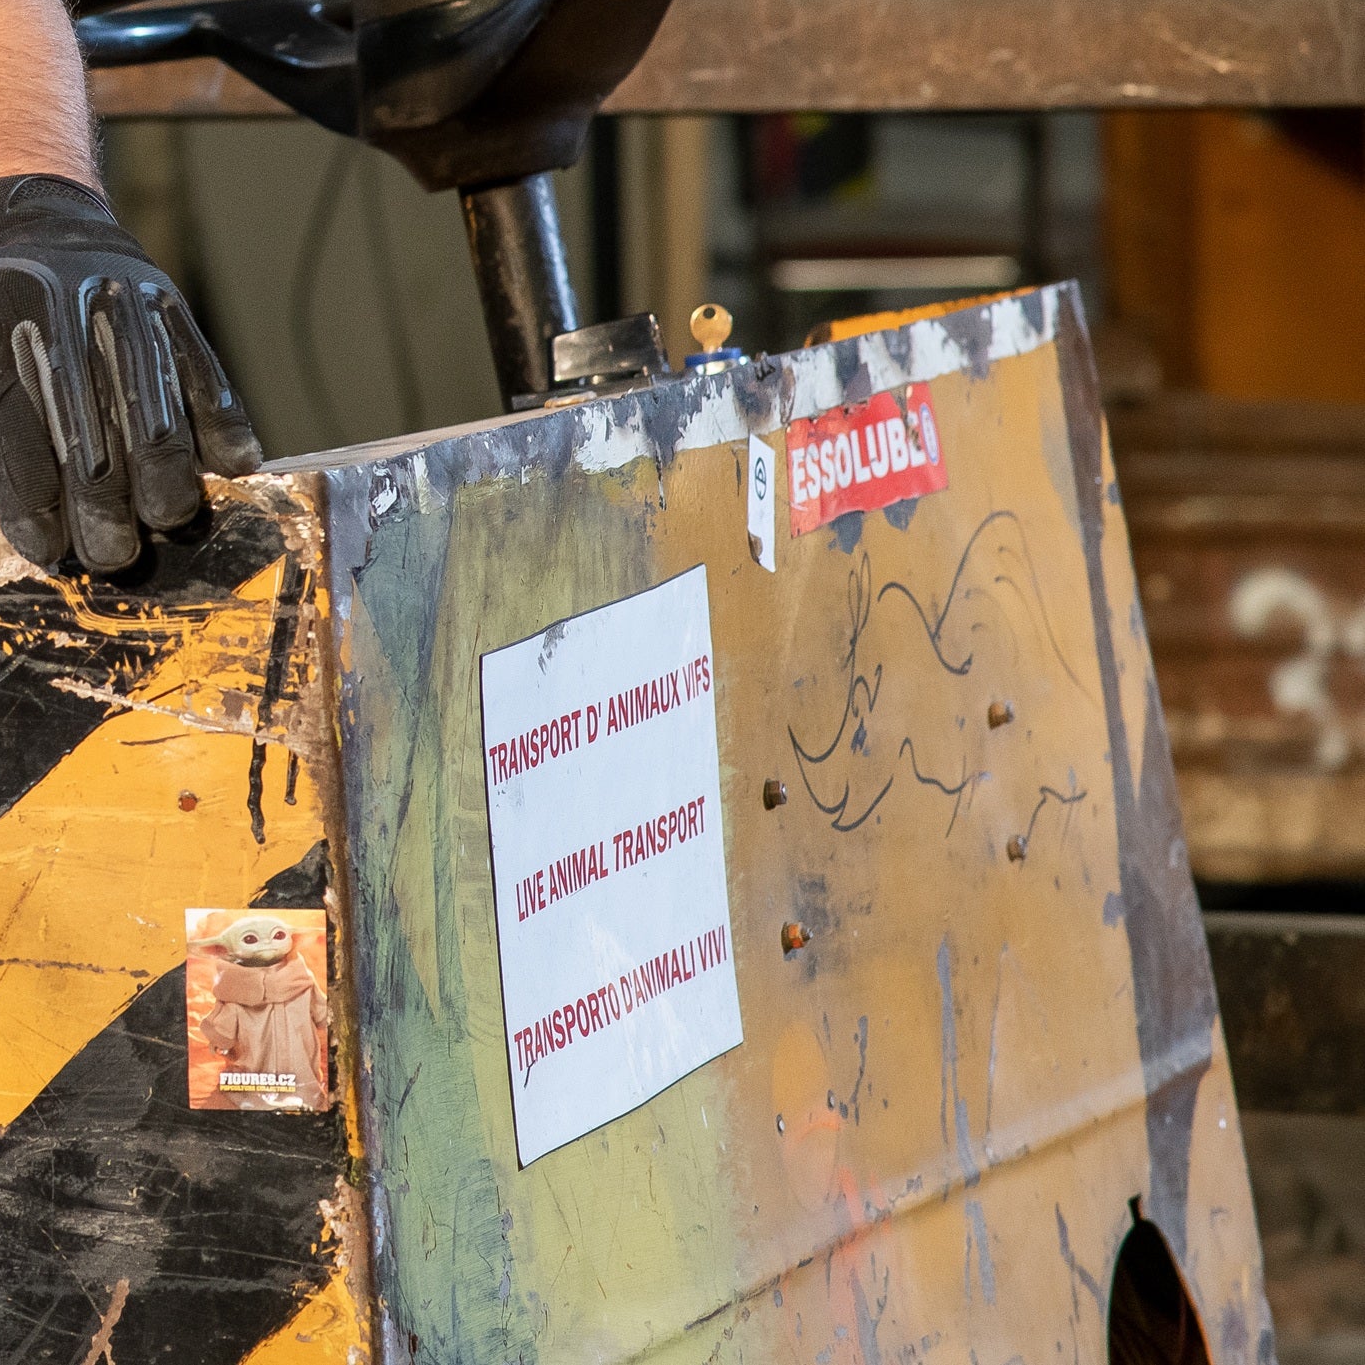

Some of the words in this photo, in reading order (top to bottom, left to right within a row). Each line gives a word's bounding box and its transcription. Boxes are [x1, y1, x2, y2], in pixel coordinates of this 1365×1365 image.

[489, 709, 581, 786] TRANSPORT
[587, 701, 602, 744] D'
[607, 670, 681, 735] ANIMAUX
[682, 654, 711, 702] VIFS
[516, 869, 546, 922] LIVE
[549, 841, 609, 905] ANIMAL
[613, 795, 706, 872] TRANSPORT
[514, 981, 620, 1072] TRANSPORTO
[619, 940, 697, 1014] D'ANIMALI
[697, 925, 726, 971] VIVI
[219, 1072, 296, 1086] FIGURES.CZ
